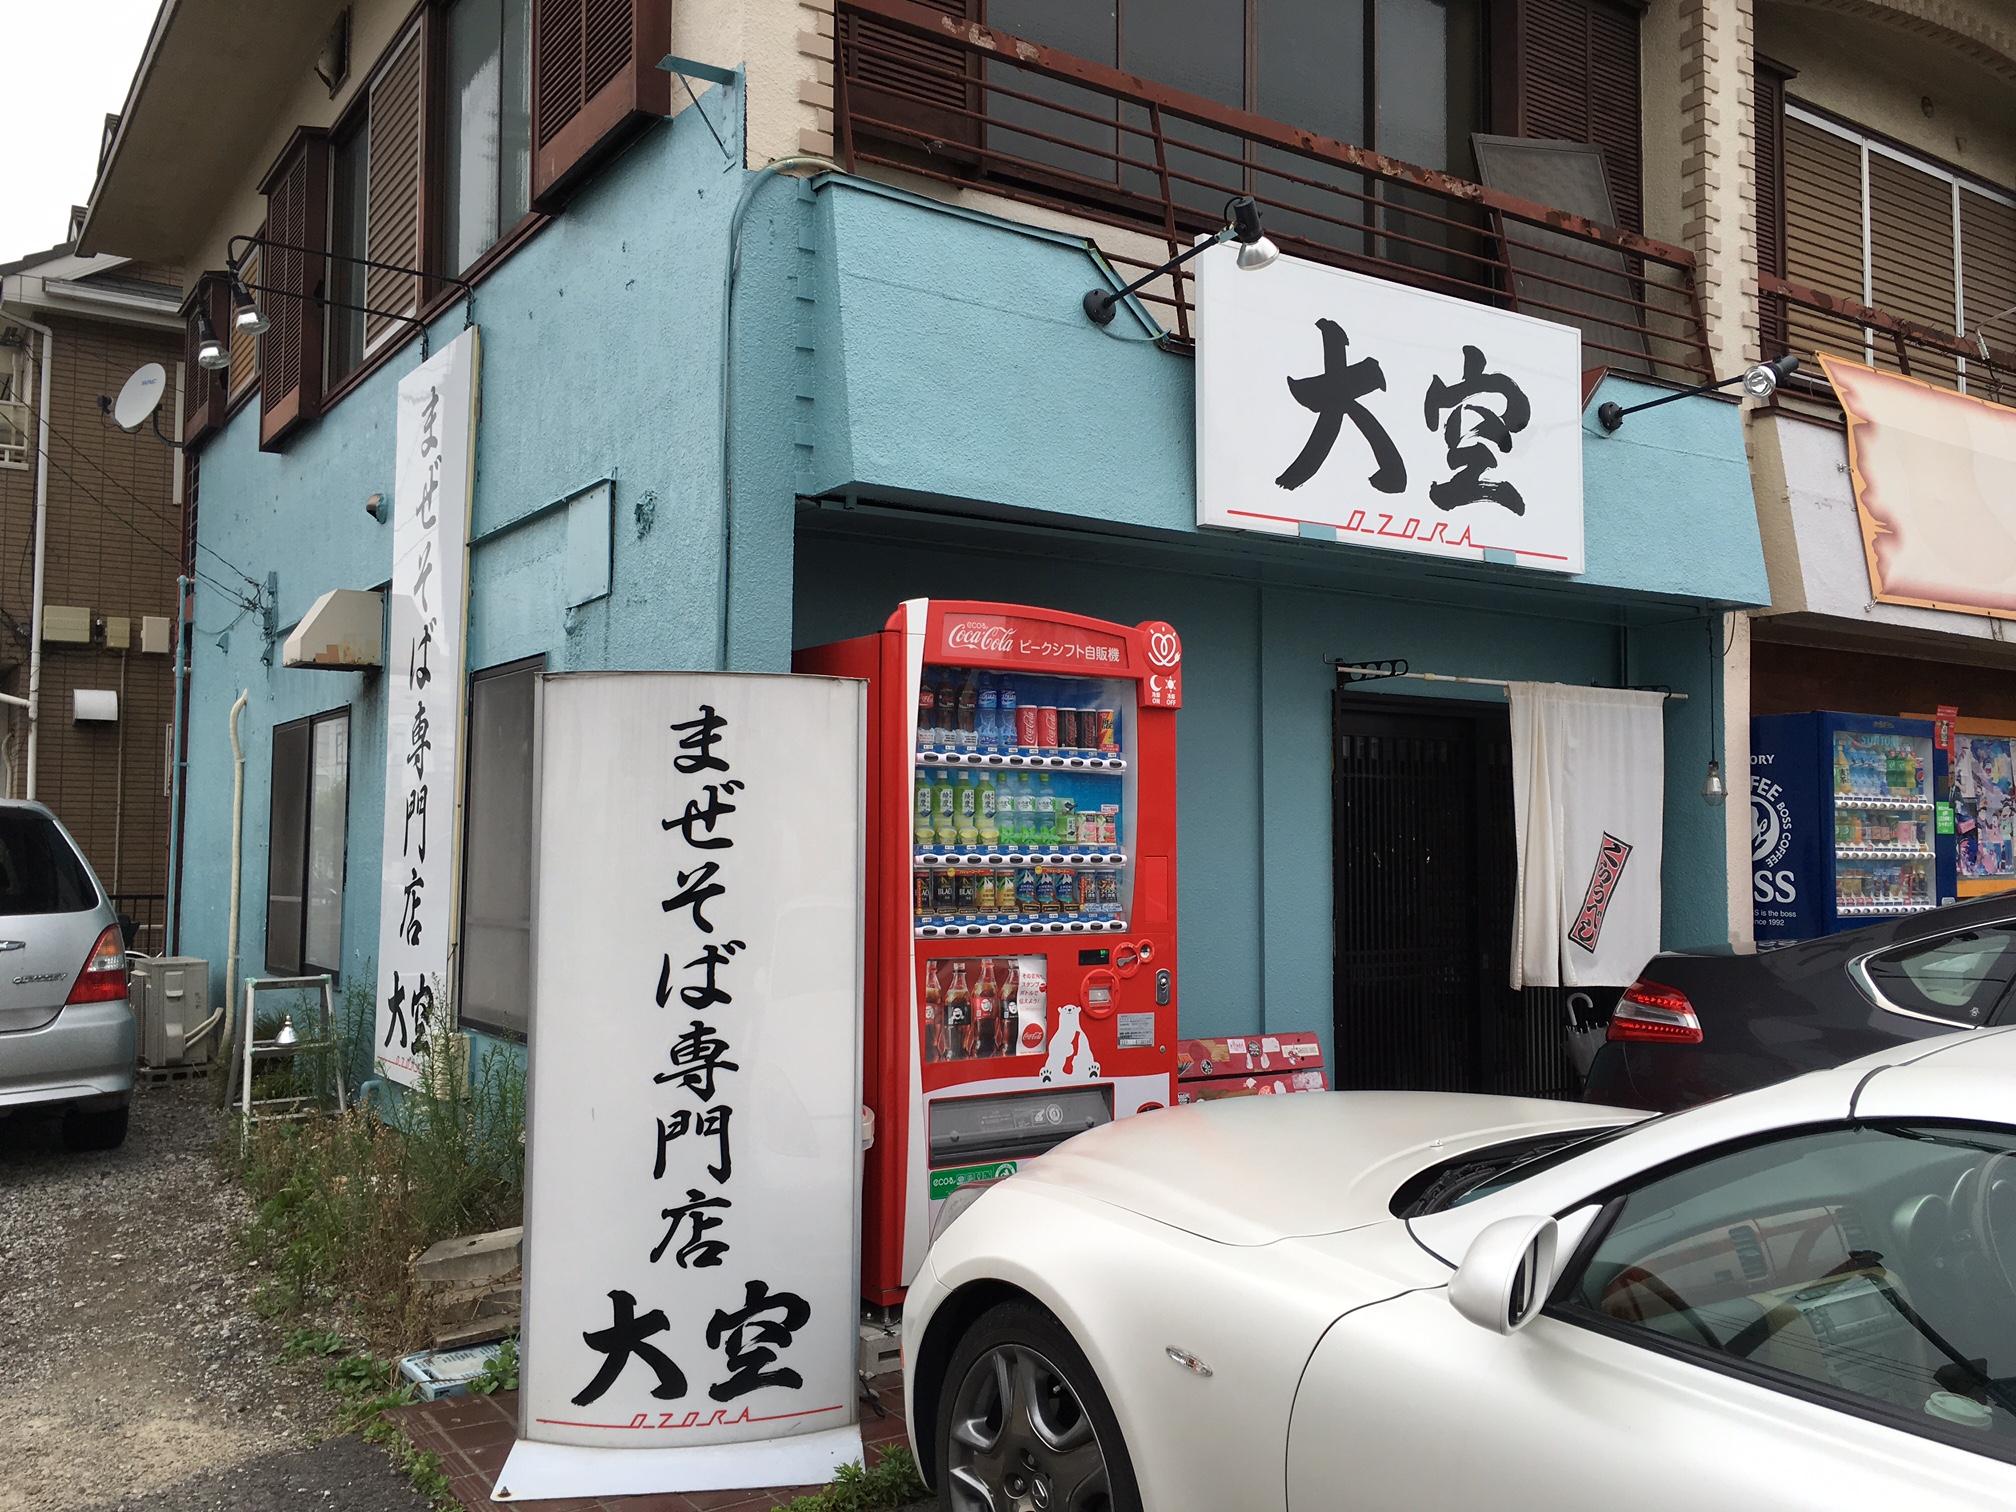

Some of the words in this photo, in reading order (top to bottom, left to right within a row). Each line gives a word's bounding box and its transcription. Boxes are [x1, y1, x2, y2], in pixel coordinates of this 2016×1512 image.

[1274, 318, 1532, 517] 大空
[1346, 509, 1473, 547] OZORA
[948, 624, 1018, 653] Coca-Cola
[1020, 639, 1120, 663] ピークシフト自販機
[400, 386, 443, 950] まぜそば専門店
[1776, 801, 1792, 830] BOSS
[1765, 832, 1792, 868] COFFEE
[1780, 910, 1797, 918] boss
[649, 705, 747, 1269] まぜそば専門店
[572, 1281, 813, 1406] 大空
[629, 1408, 751, 1430] OZORA
